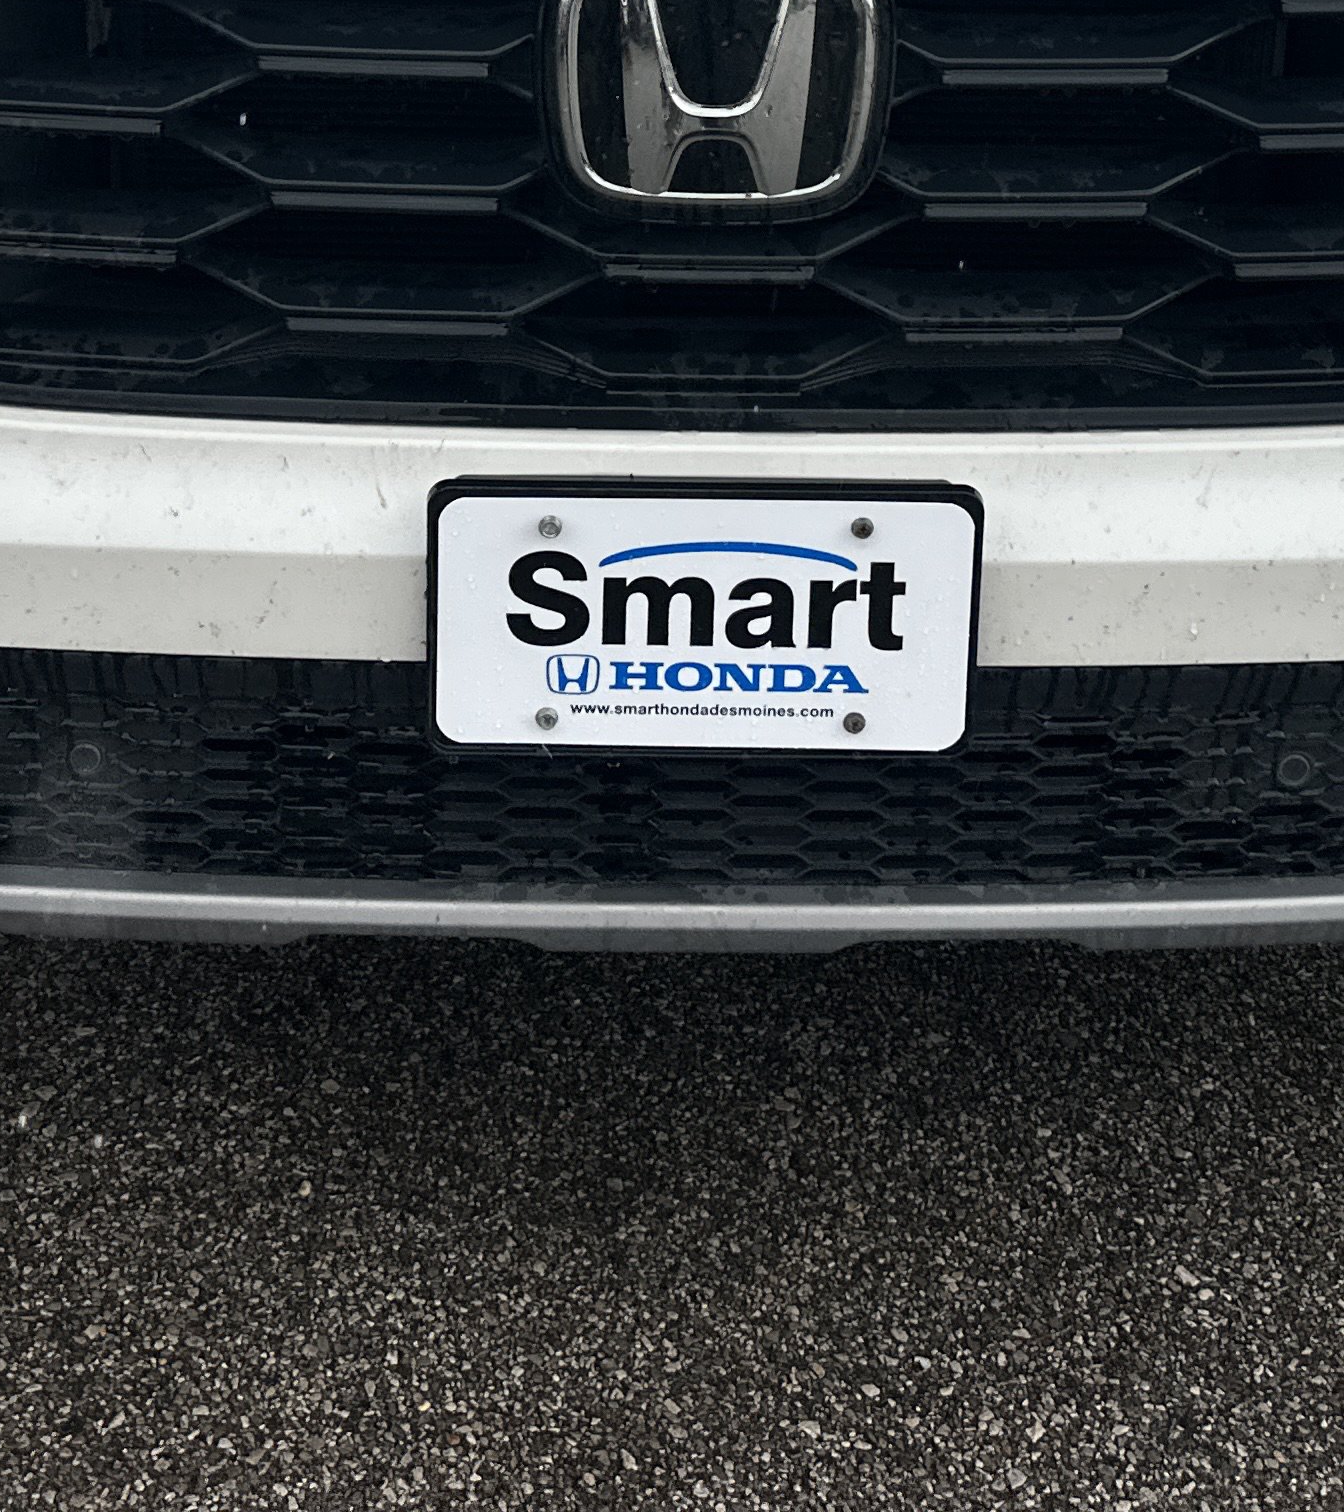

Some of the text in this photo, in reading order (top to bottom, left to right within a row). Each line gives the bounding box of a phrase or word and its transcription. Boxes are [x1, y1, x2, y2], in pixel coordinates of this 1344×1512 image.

[505, 550, 907, 651] Smart
[609, 661, 869, 694] HONDA
[570, 702, 834, 719] www.smarthondadesmoines.com
